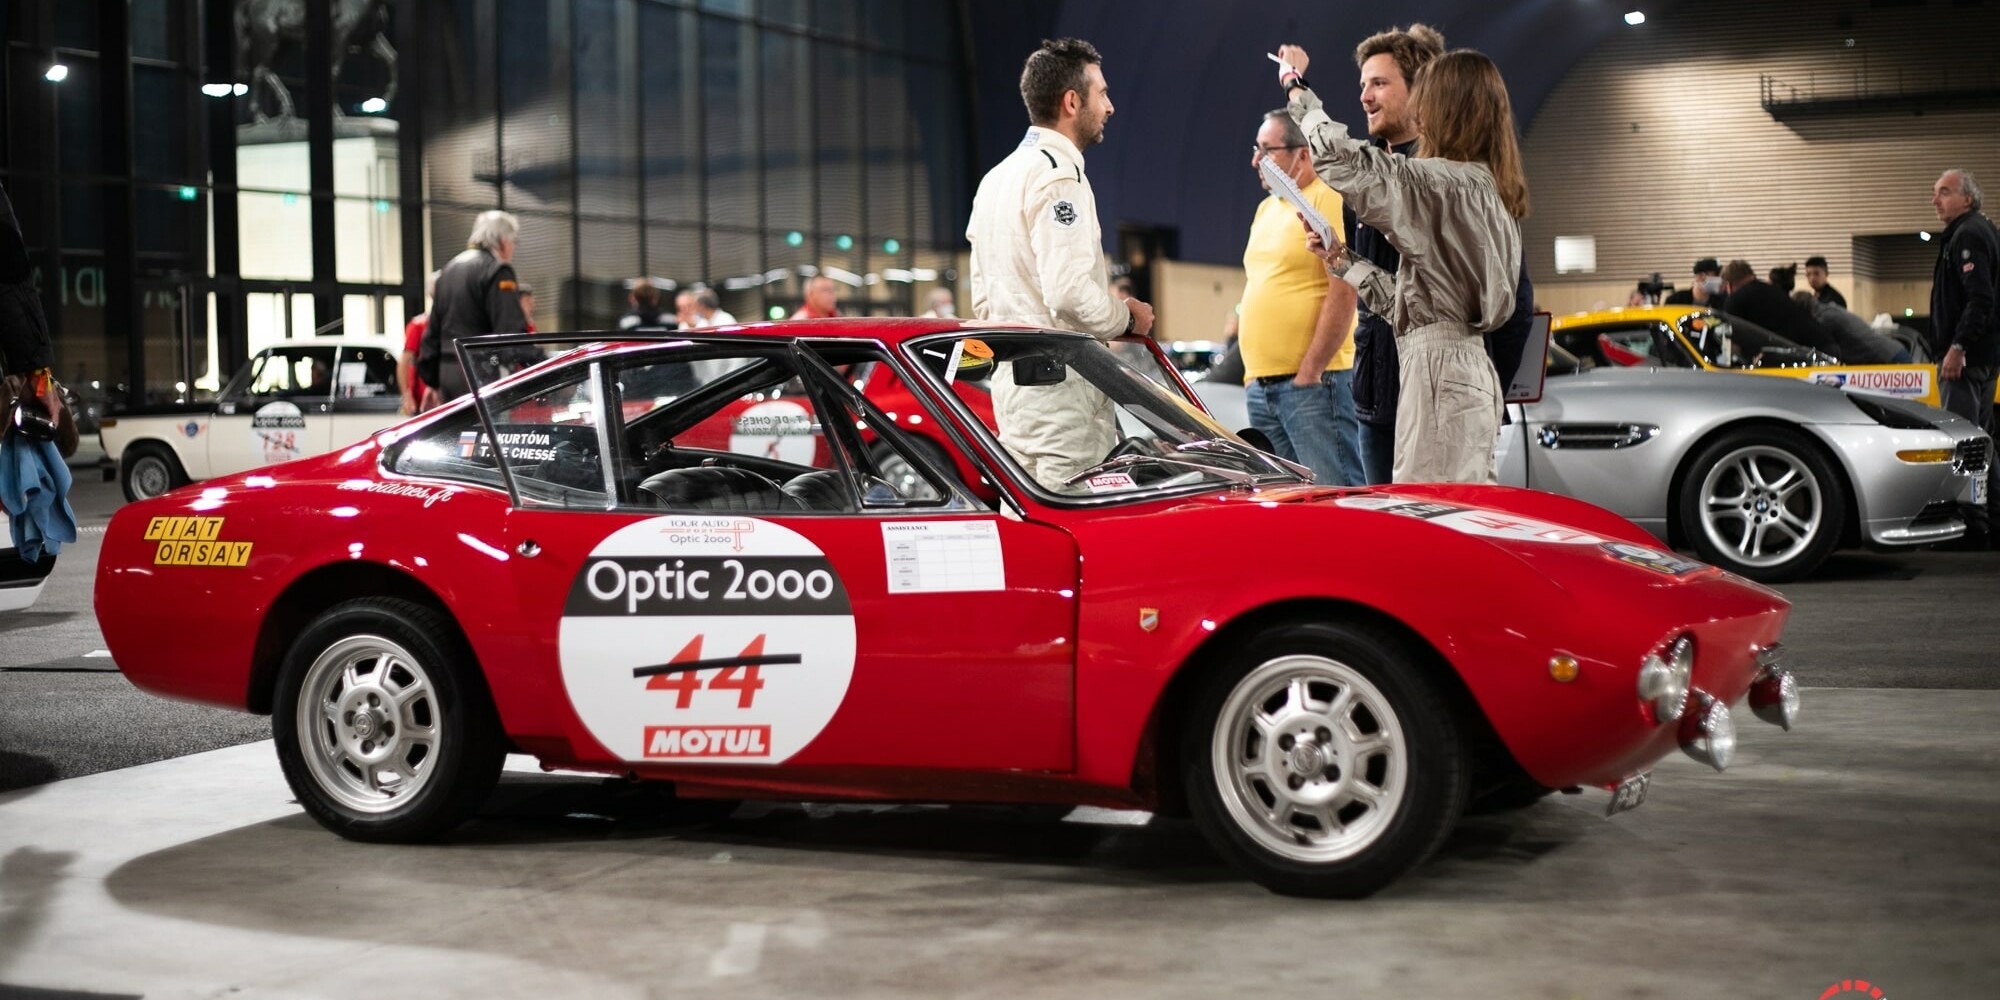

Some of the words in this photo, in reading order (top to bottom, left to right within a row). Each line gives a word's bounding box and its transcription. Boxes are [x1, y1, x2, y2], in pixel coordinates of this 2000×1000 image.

[1849, 373, 1923, 388] AUTOVISION
[479, 446, 490, 457] T.
[511, 447, 558, 461] CHESSÉ
[1092, 476, 1129, 486] MOTUL
[150, 520, 219, 537] FIAT
[670, 534, 701, 546] Optic
[704, 535, 732, 543] 2000
[160, 544, 248, 562] ORSAY
[587, 559, 710, 613] Optic
[722, 559, 834, 600] 2000
[645, 633, 766, 709] 44
[648, 729, 765, 754] MOTUL
